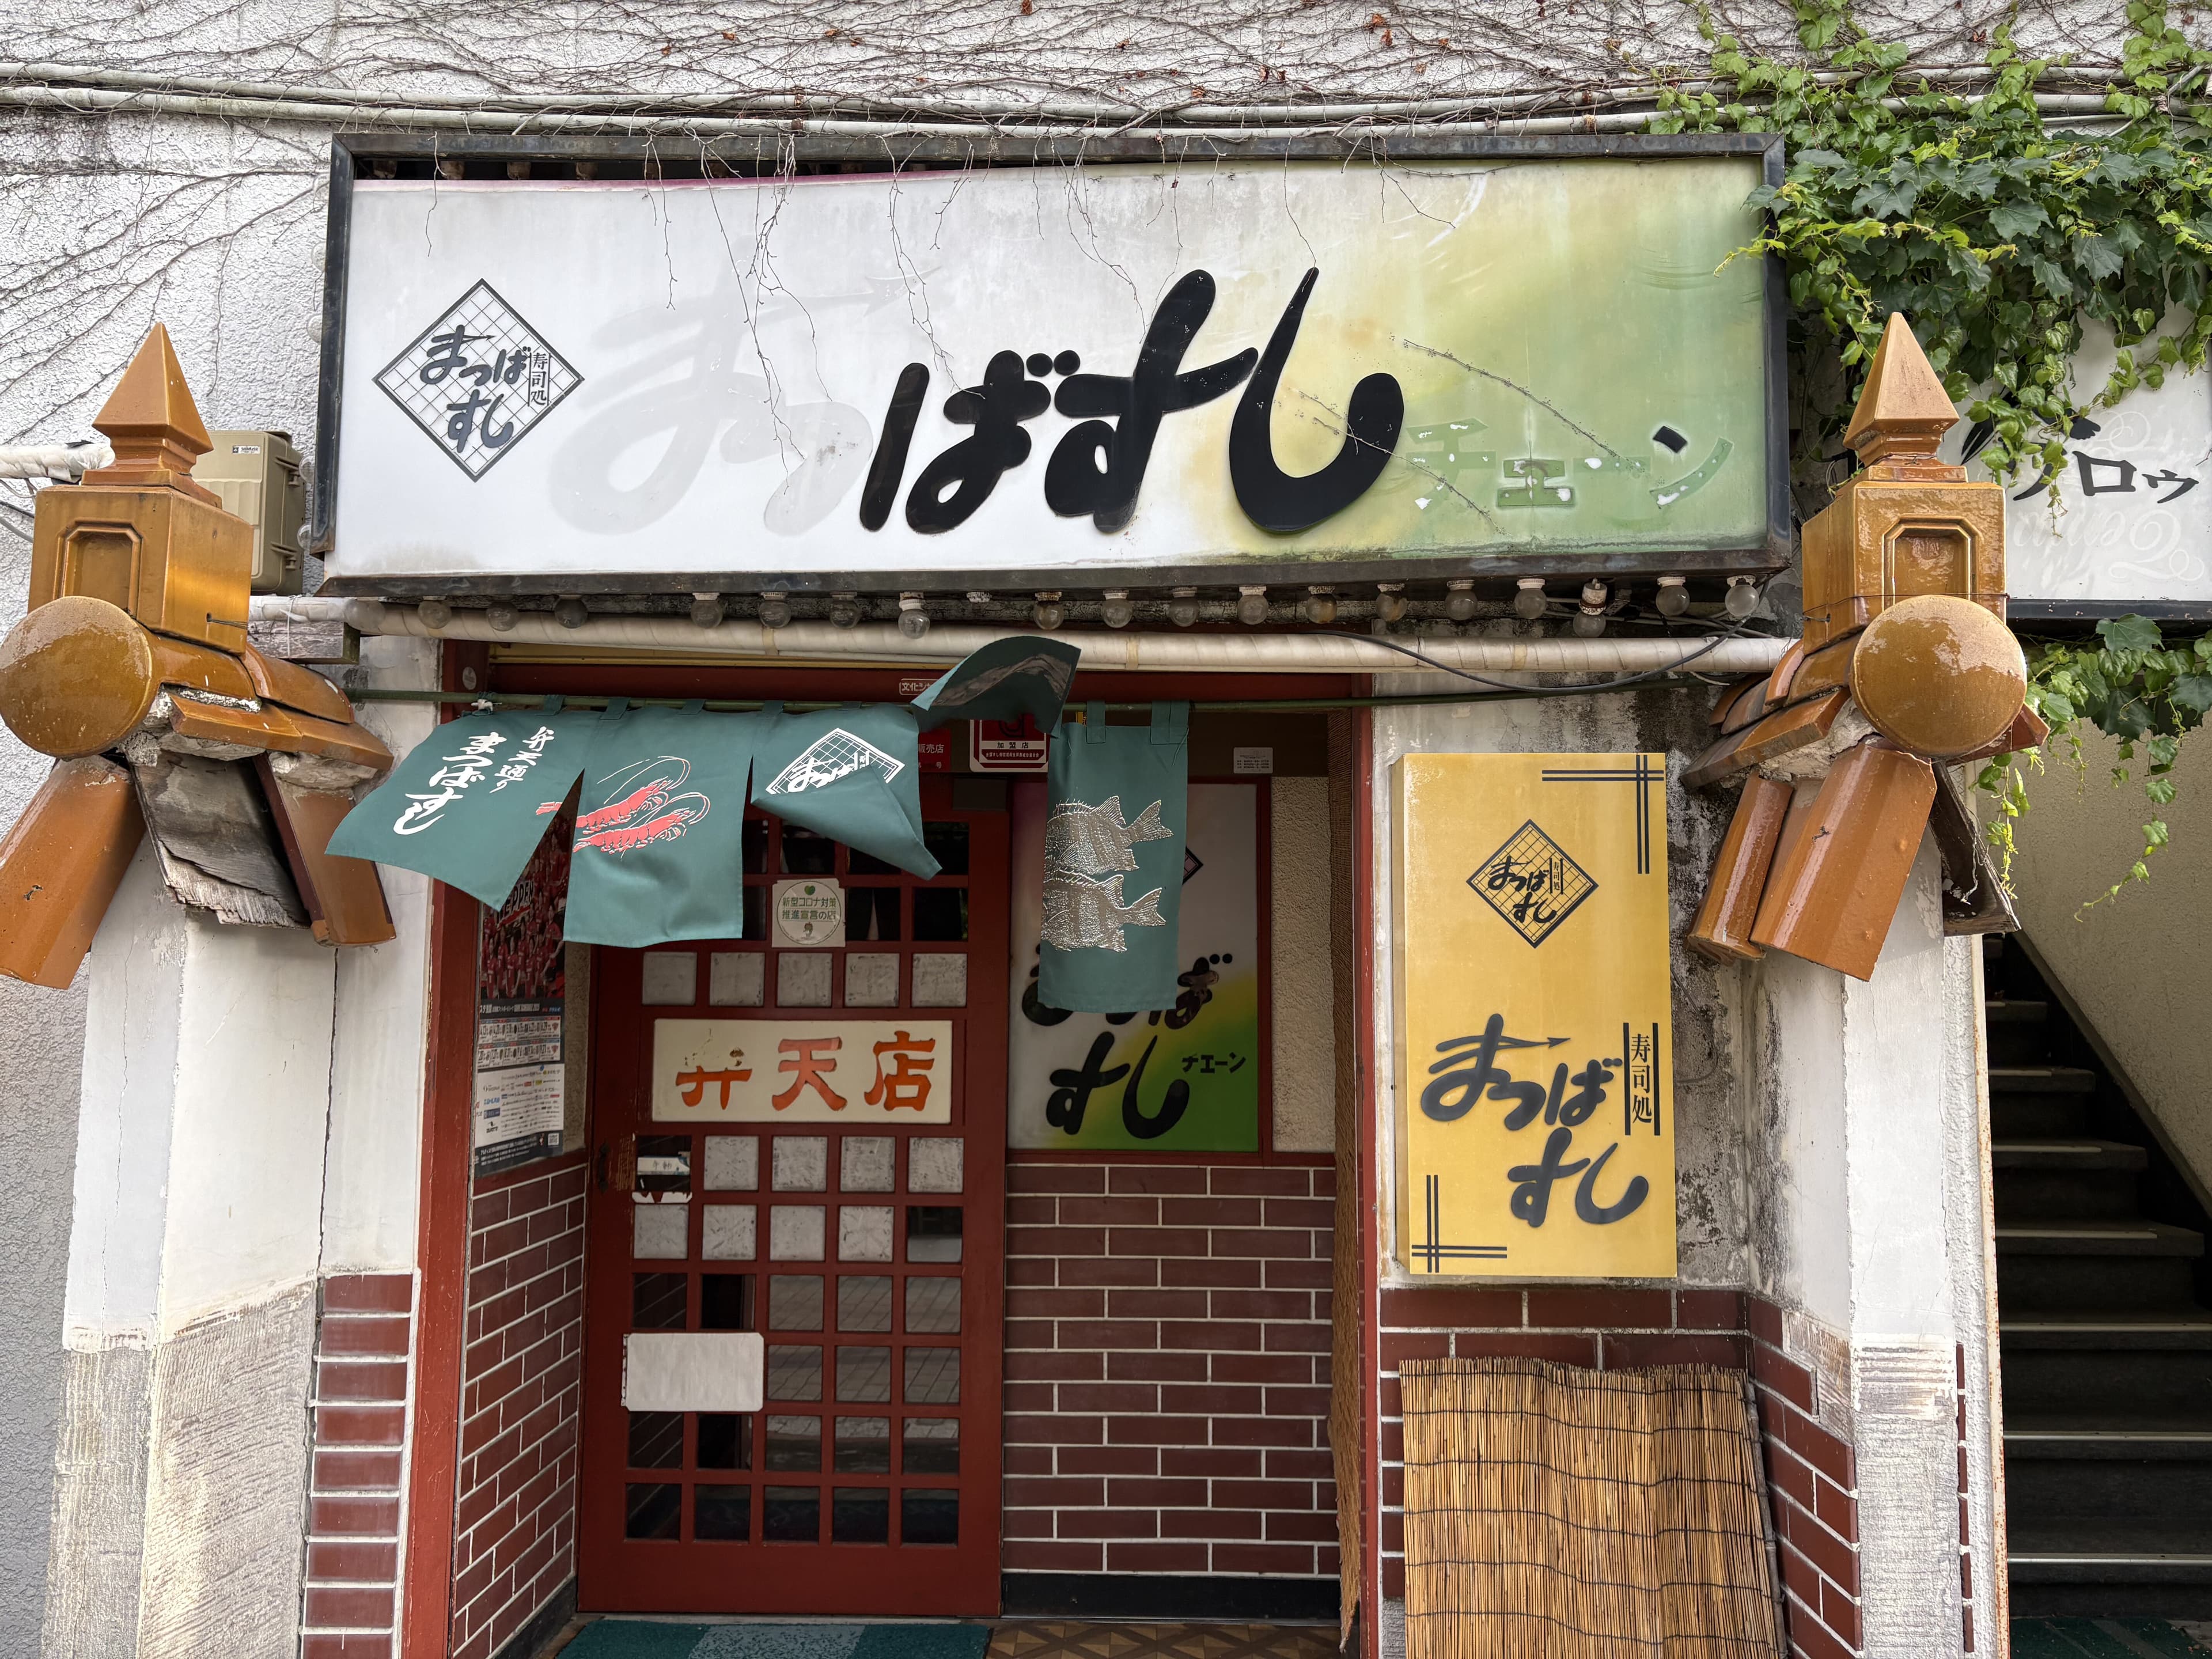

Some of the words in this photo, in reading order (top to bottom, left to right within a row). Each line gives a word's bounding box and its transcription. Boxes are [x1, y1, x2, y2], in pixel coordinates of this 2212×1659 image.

[530, 352, 549, 406] 寿司処
[782, 897, 836, 908] 新型コロナ対策
[782, 910, 836, 920] 推進宣言の店
[1631, 1033, 1653, 1124] 寿司処
